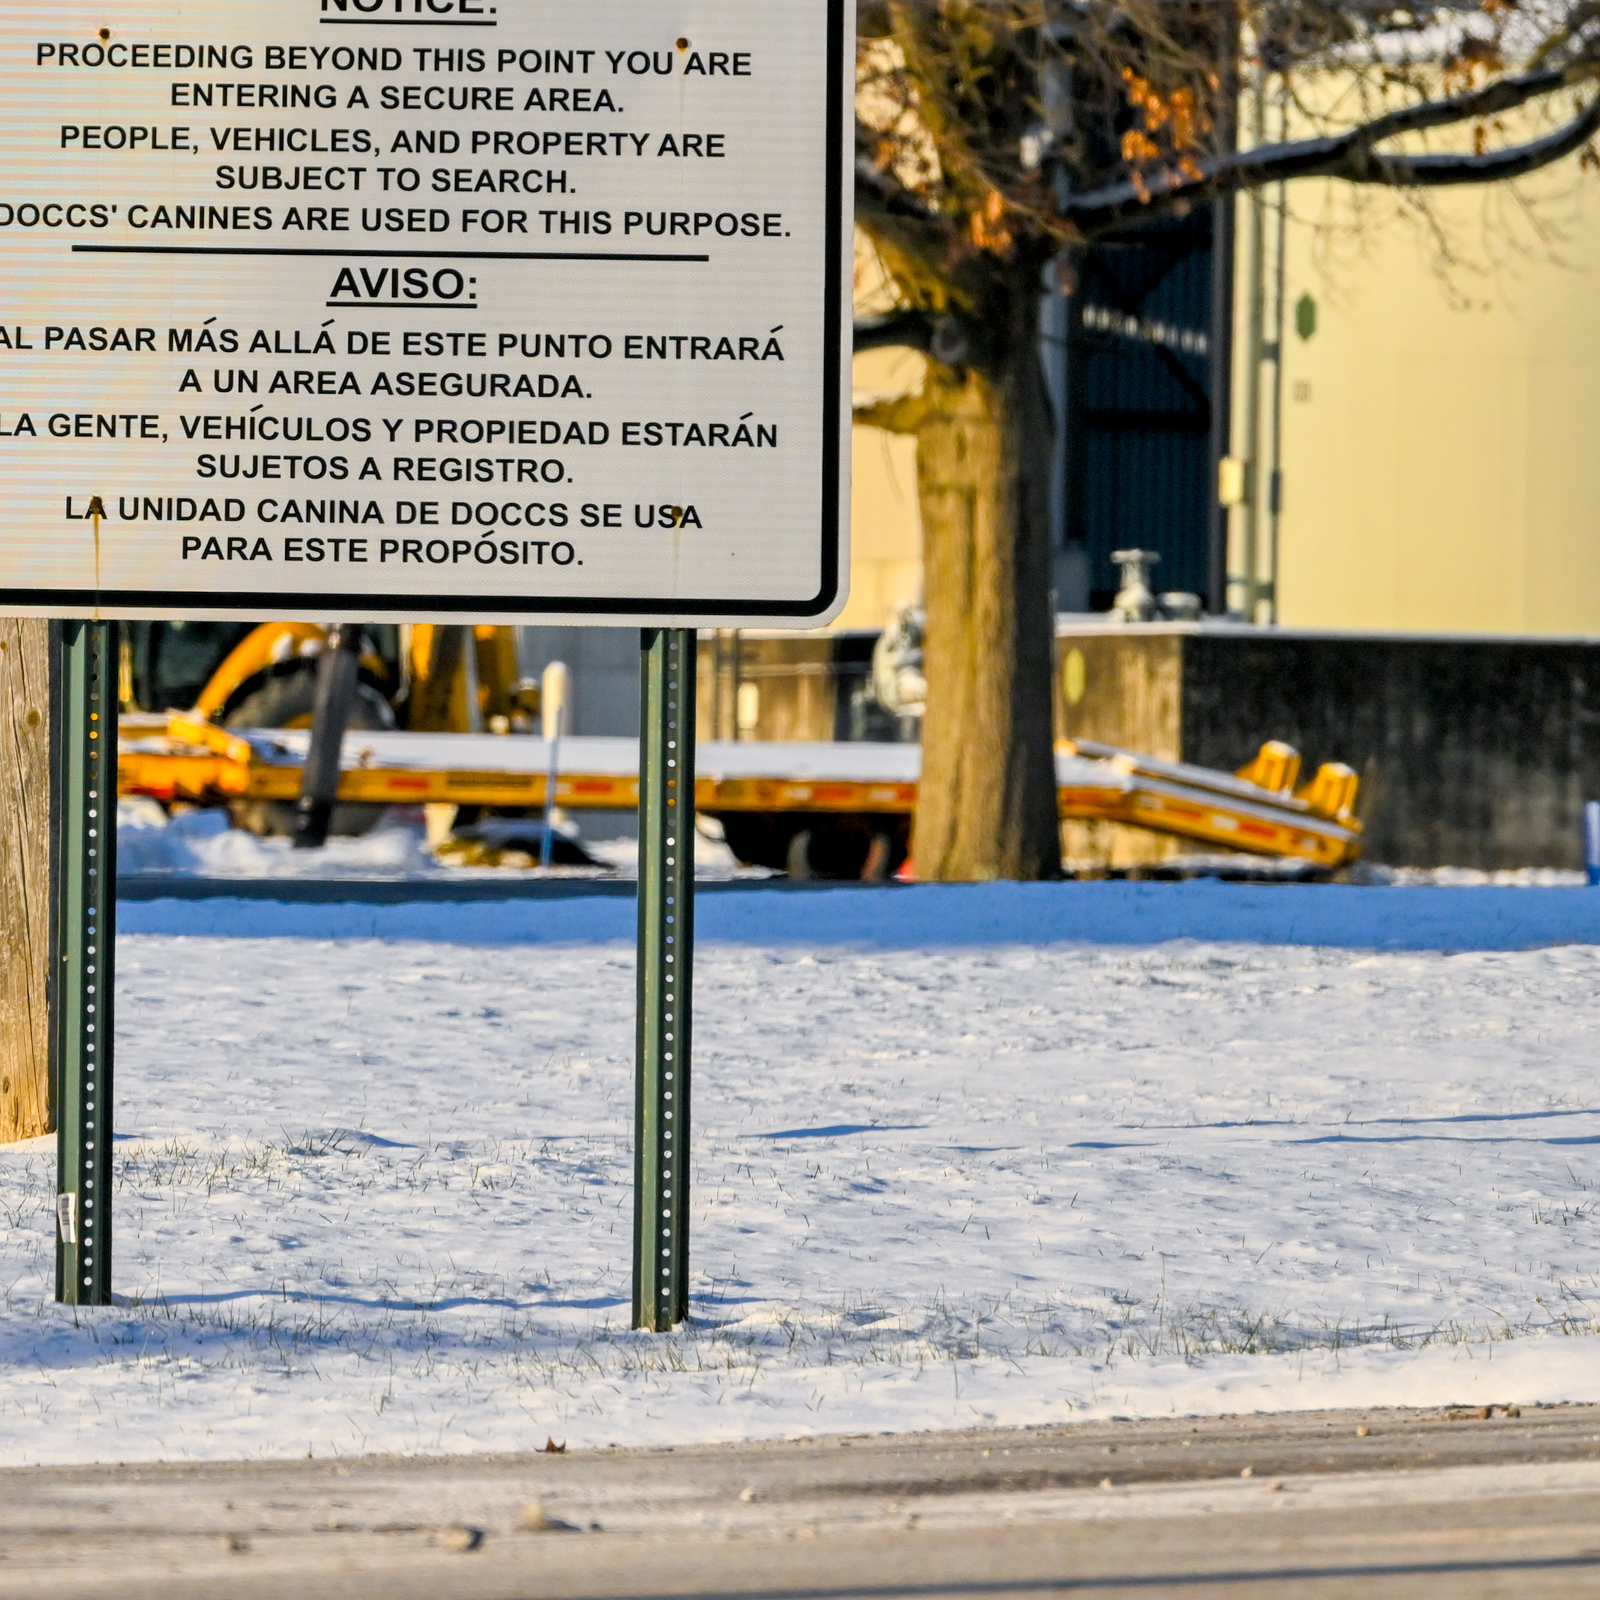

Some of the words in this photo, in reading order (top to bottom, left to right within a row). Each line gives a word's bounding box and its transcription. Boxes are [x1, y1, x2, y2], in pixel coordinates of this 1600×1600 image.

[36, 42, 253, 70] PROCEEDING
[265, 45, 402, 72] BEYOND
[413, 48, 486, 73] THIS
[497, 49, 594, 74] POINT
[604, 50, 673, 75] YOU
[684, 51, 752, 76] ARE
[171, 82, 337, 110] ENTERING
[346, 85, 370, 109] A
[380, 85, 514, 111] SECURE
[524, 87, 625, 113] AREA.
[60, 125, 199, 155] PEOPLE,
[209, 127, 380, 158] VEHICLES,
[390, 129, 460, 154] AND
[471, 131, 649, 157] PROPERTY
[657, 133, 725, 158] ARE
[215, 165, 367, 191] SUBJECT
[377, 167, 421, 192] TO
[431, 168, 576, 194] SEARCH.
[127, 204, 273, 230] CANINES
[281, 206, 350, 231] ARE
[361, 207, 450, 233] USED
[461, 209, 528, 234] FOR
[538, 210, 612, 235] THIS
[624, 211, 791, 237] PURPOSE.
[329, 267, 477, 300] AVISO:
[45, 327, 157, 352] PASAR
[168, 317, 239, 353] MÁS
[248, 319, 336, 355] ALLÁ
[347, 331, 391, 356] DE
[402, 332, 487, 357] ESTE
[498, 334, 613, 359] PUNTO
[624, 325, 785, 361] ENTRARÁ
[178, 368, 203, 393] A
[214, 370, 258, 394] UN
[268, 371, 361, 396] AREA
[370, 372, 593, 399] ASEGURADA.
[48, 413, 168, 444] GENTE,
[179, 404, 372, 443] VEHÍCULOS
[381, 418, 404, 443] Y
[414, 419, 610, 445] PROPIEDAD
[621, 412, 778, 448] ESTARÁN
[196, 453, 349, 481] SUJETOS
[358, 456, 382, 481] A
[393, 457, 573, 484] REGISTRO.
[119, 496, 246, 522] UNIDAD
[257, 498, 385, 525] CANINA
[396, 500, 439, 525] DE
[451, 501, 569, 528] DOCCS
[579, 503, 623, 528] SE
[634, 504, 703, 529] USA
[182, 536, 273, 561] PARA
[284, 537, 368, 563] ESTE
[380, 529, 584, 566] PROPÓSITO.
